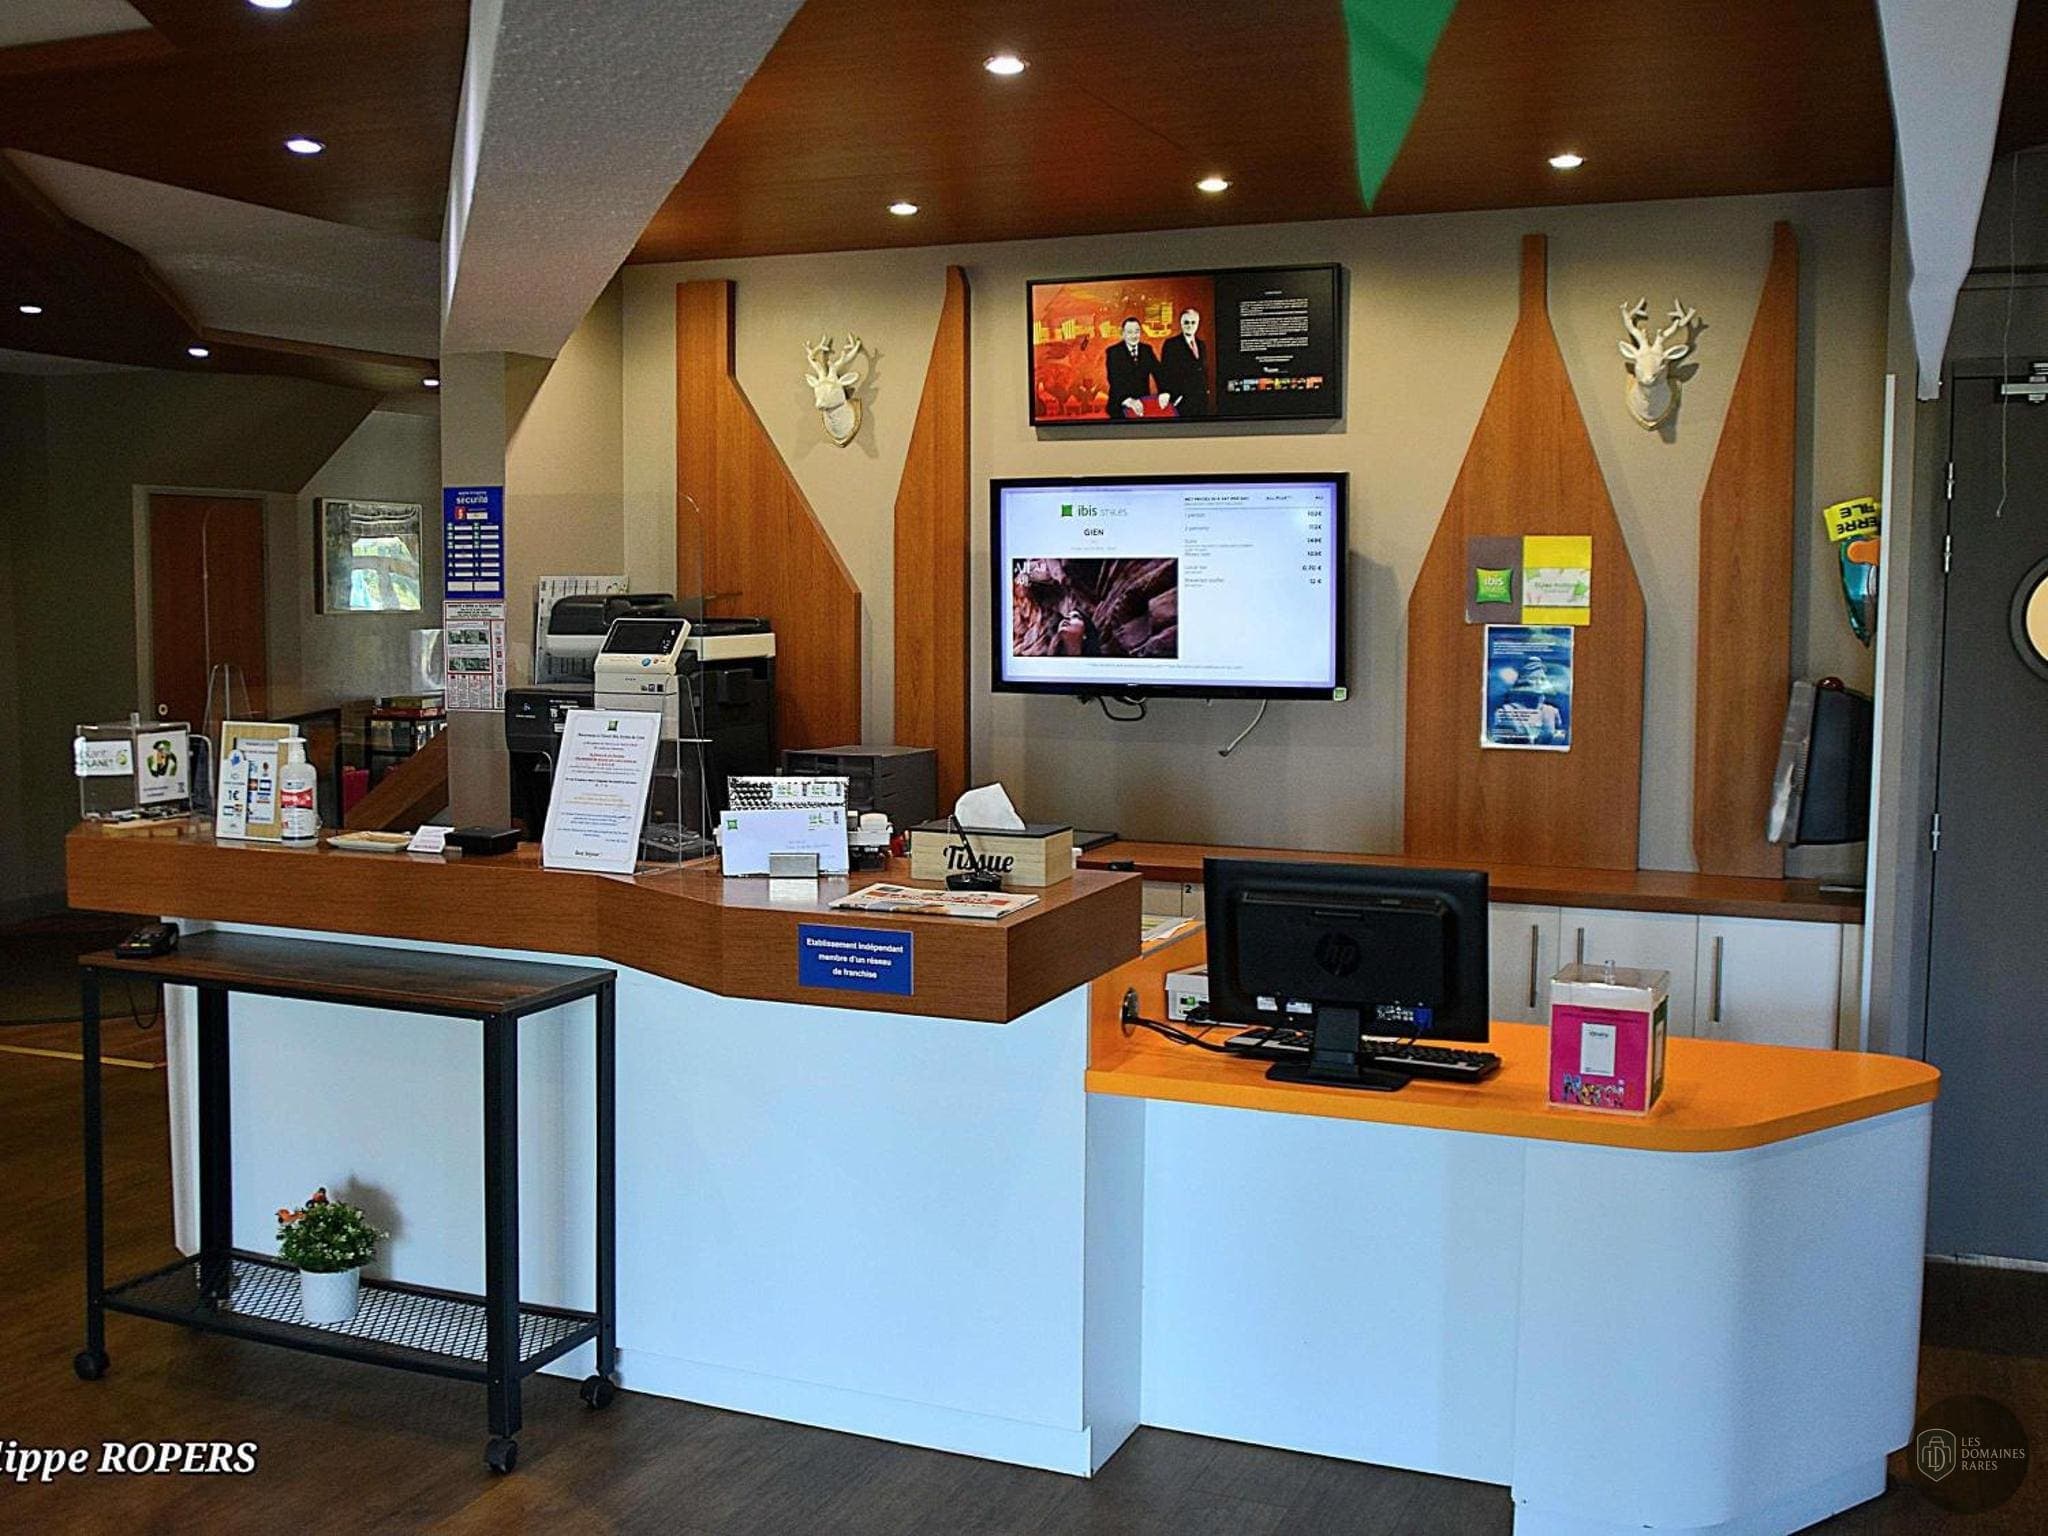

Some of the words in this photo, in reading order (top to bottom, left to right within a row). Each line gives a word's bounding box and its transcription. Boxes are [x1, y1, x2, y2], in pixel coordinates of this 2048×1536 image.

[1078, 504, 1098, 517] ibis
[1836, 516, 1879, 534] ERRE
[1083, 528, 1104, 536] GIEN
[943, 845, 1014, 873] Tissue
[1184, 885, 1192, 894] 2
[818, 953, 847, 962] membre
[848, 955, 866, 964] d'un
[832, 967, 843, 976] de
[843, 968, 877, 979] franchise
